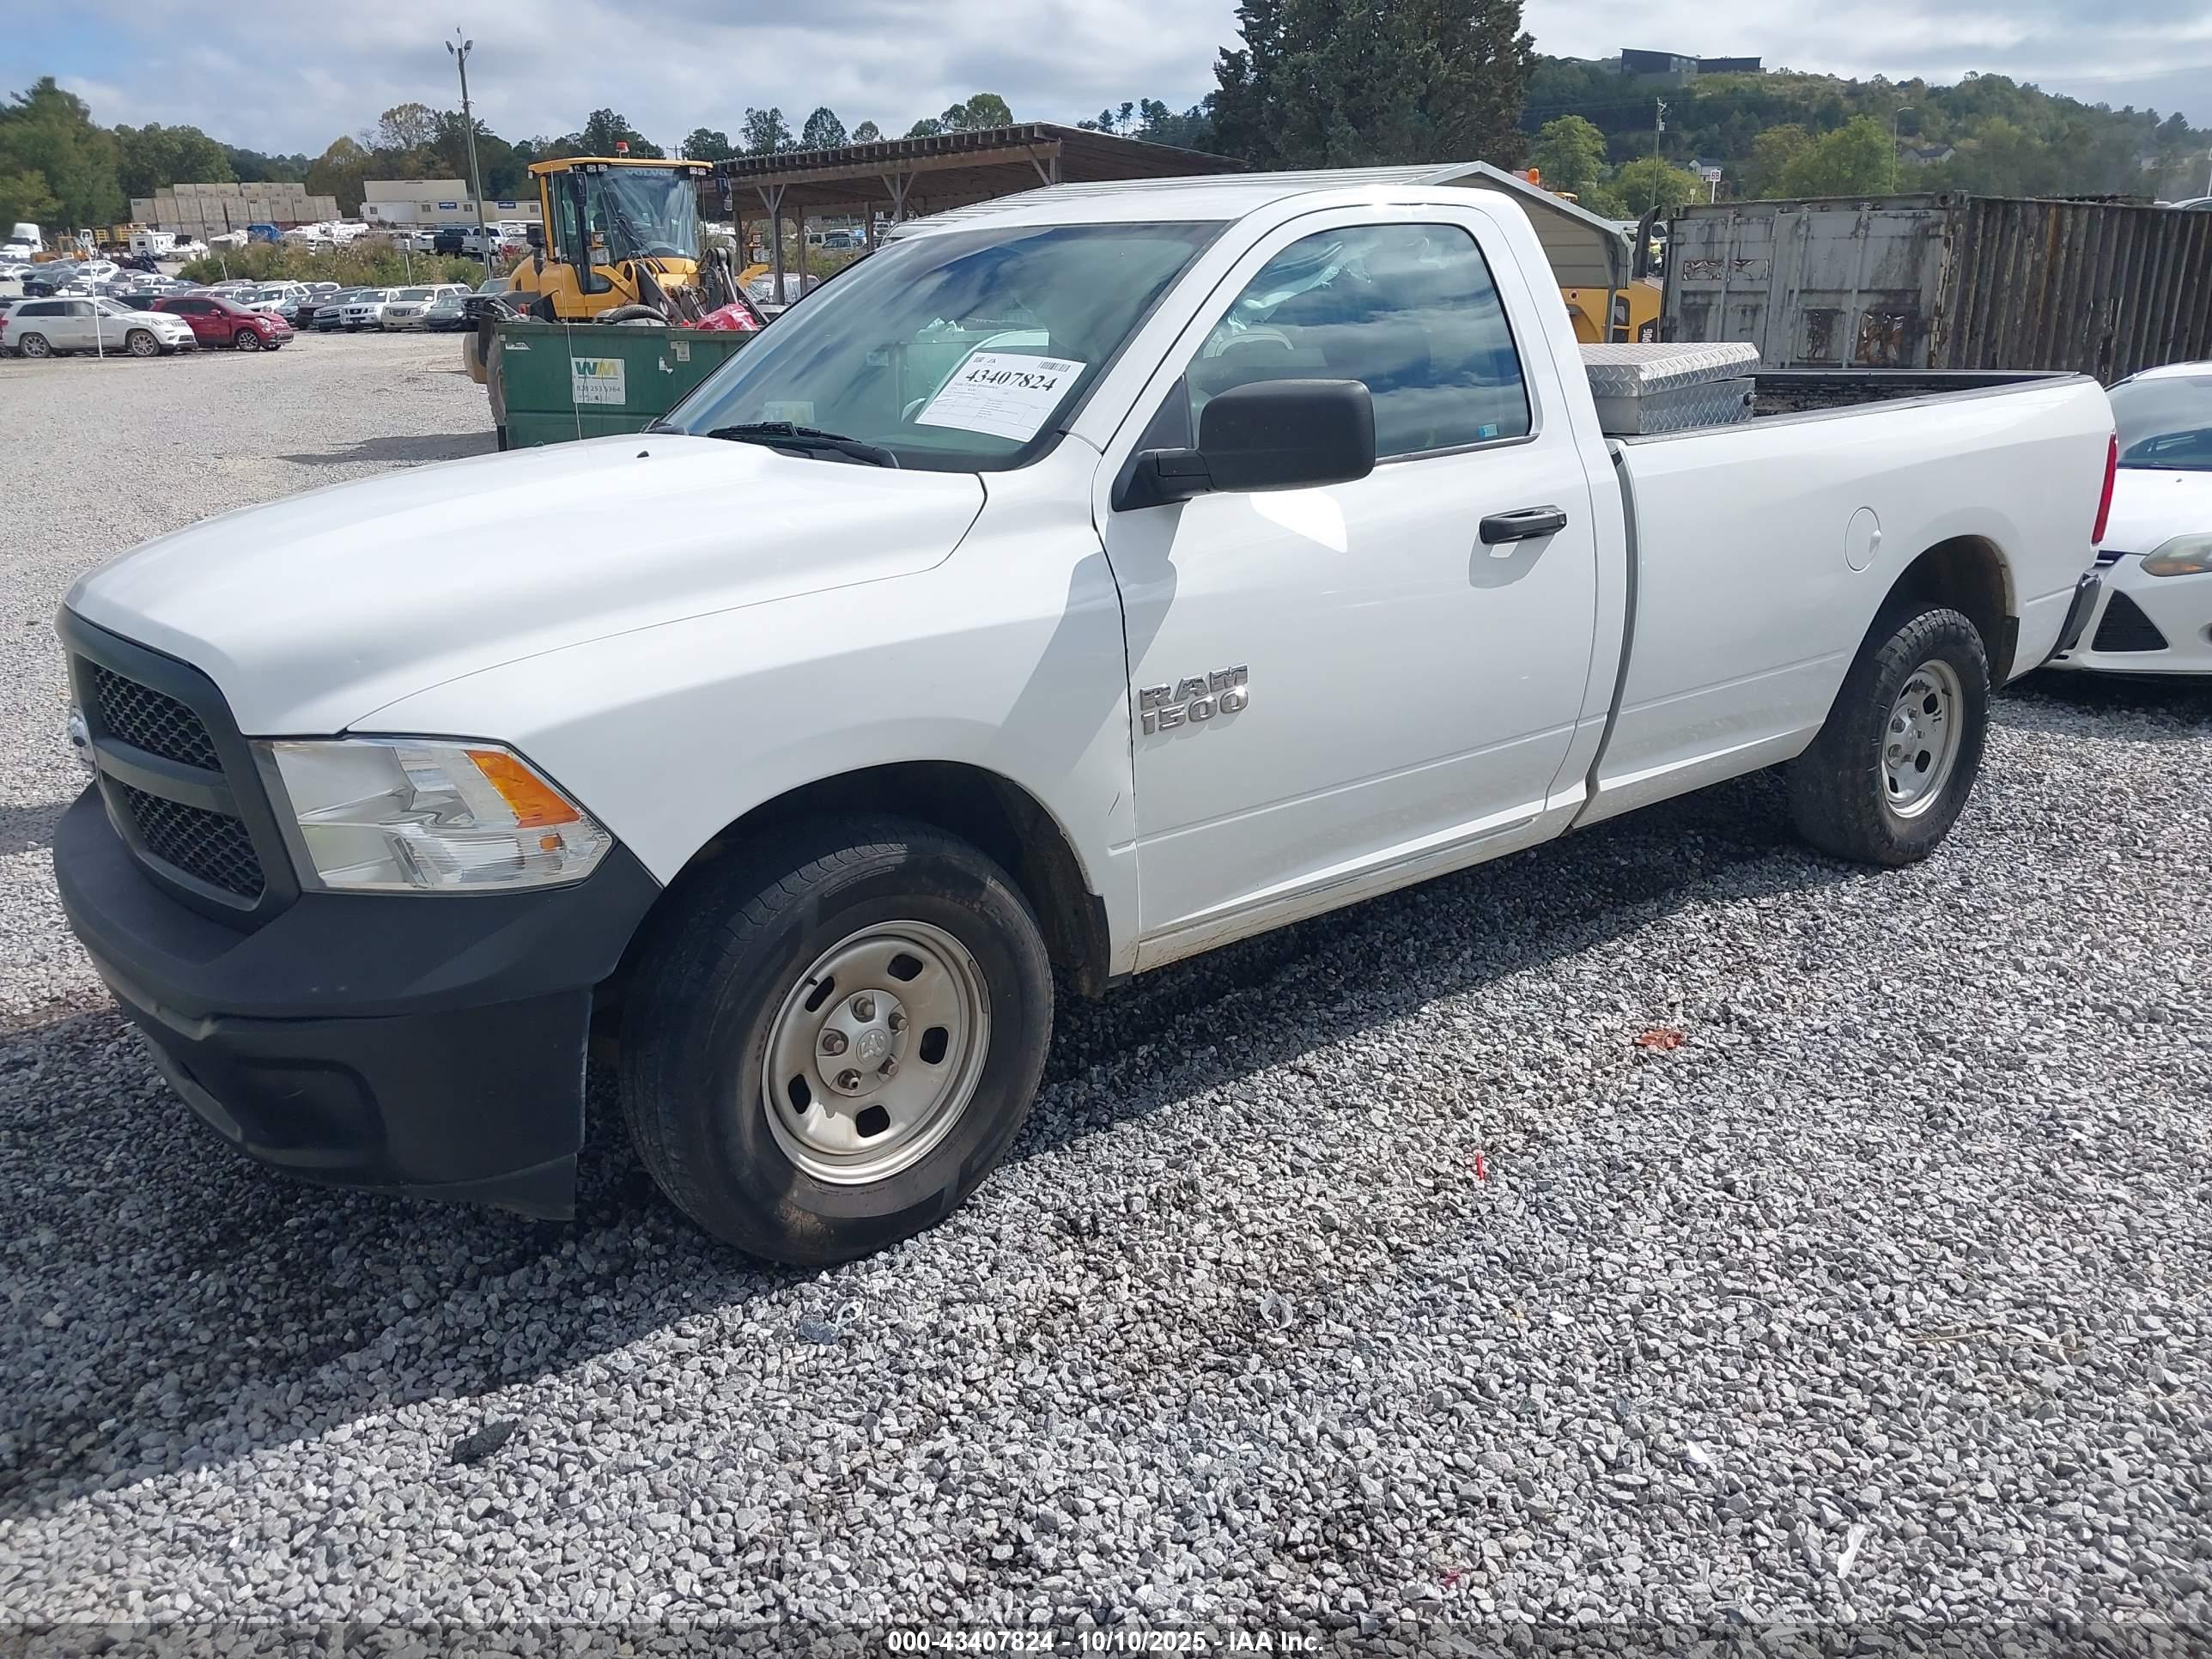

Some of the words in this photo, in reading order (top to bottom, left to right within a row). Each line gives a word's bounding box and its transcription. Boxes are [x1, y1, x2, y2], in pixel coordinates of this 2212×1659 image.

[625, 168, 668, 177] VOLVO
[575, 362, 618, 376] WM
[965, 369, 1059, 392] 43407824
[1139, 663, 1249, 711] RAM
[1140, 685, 1249, 736] 1500
